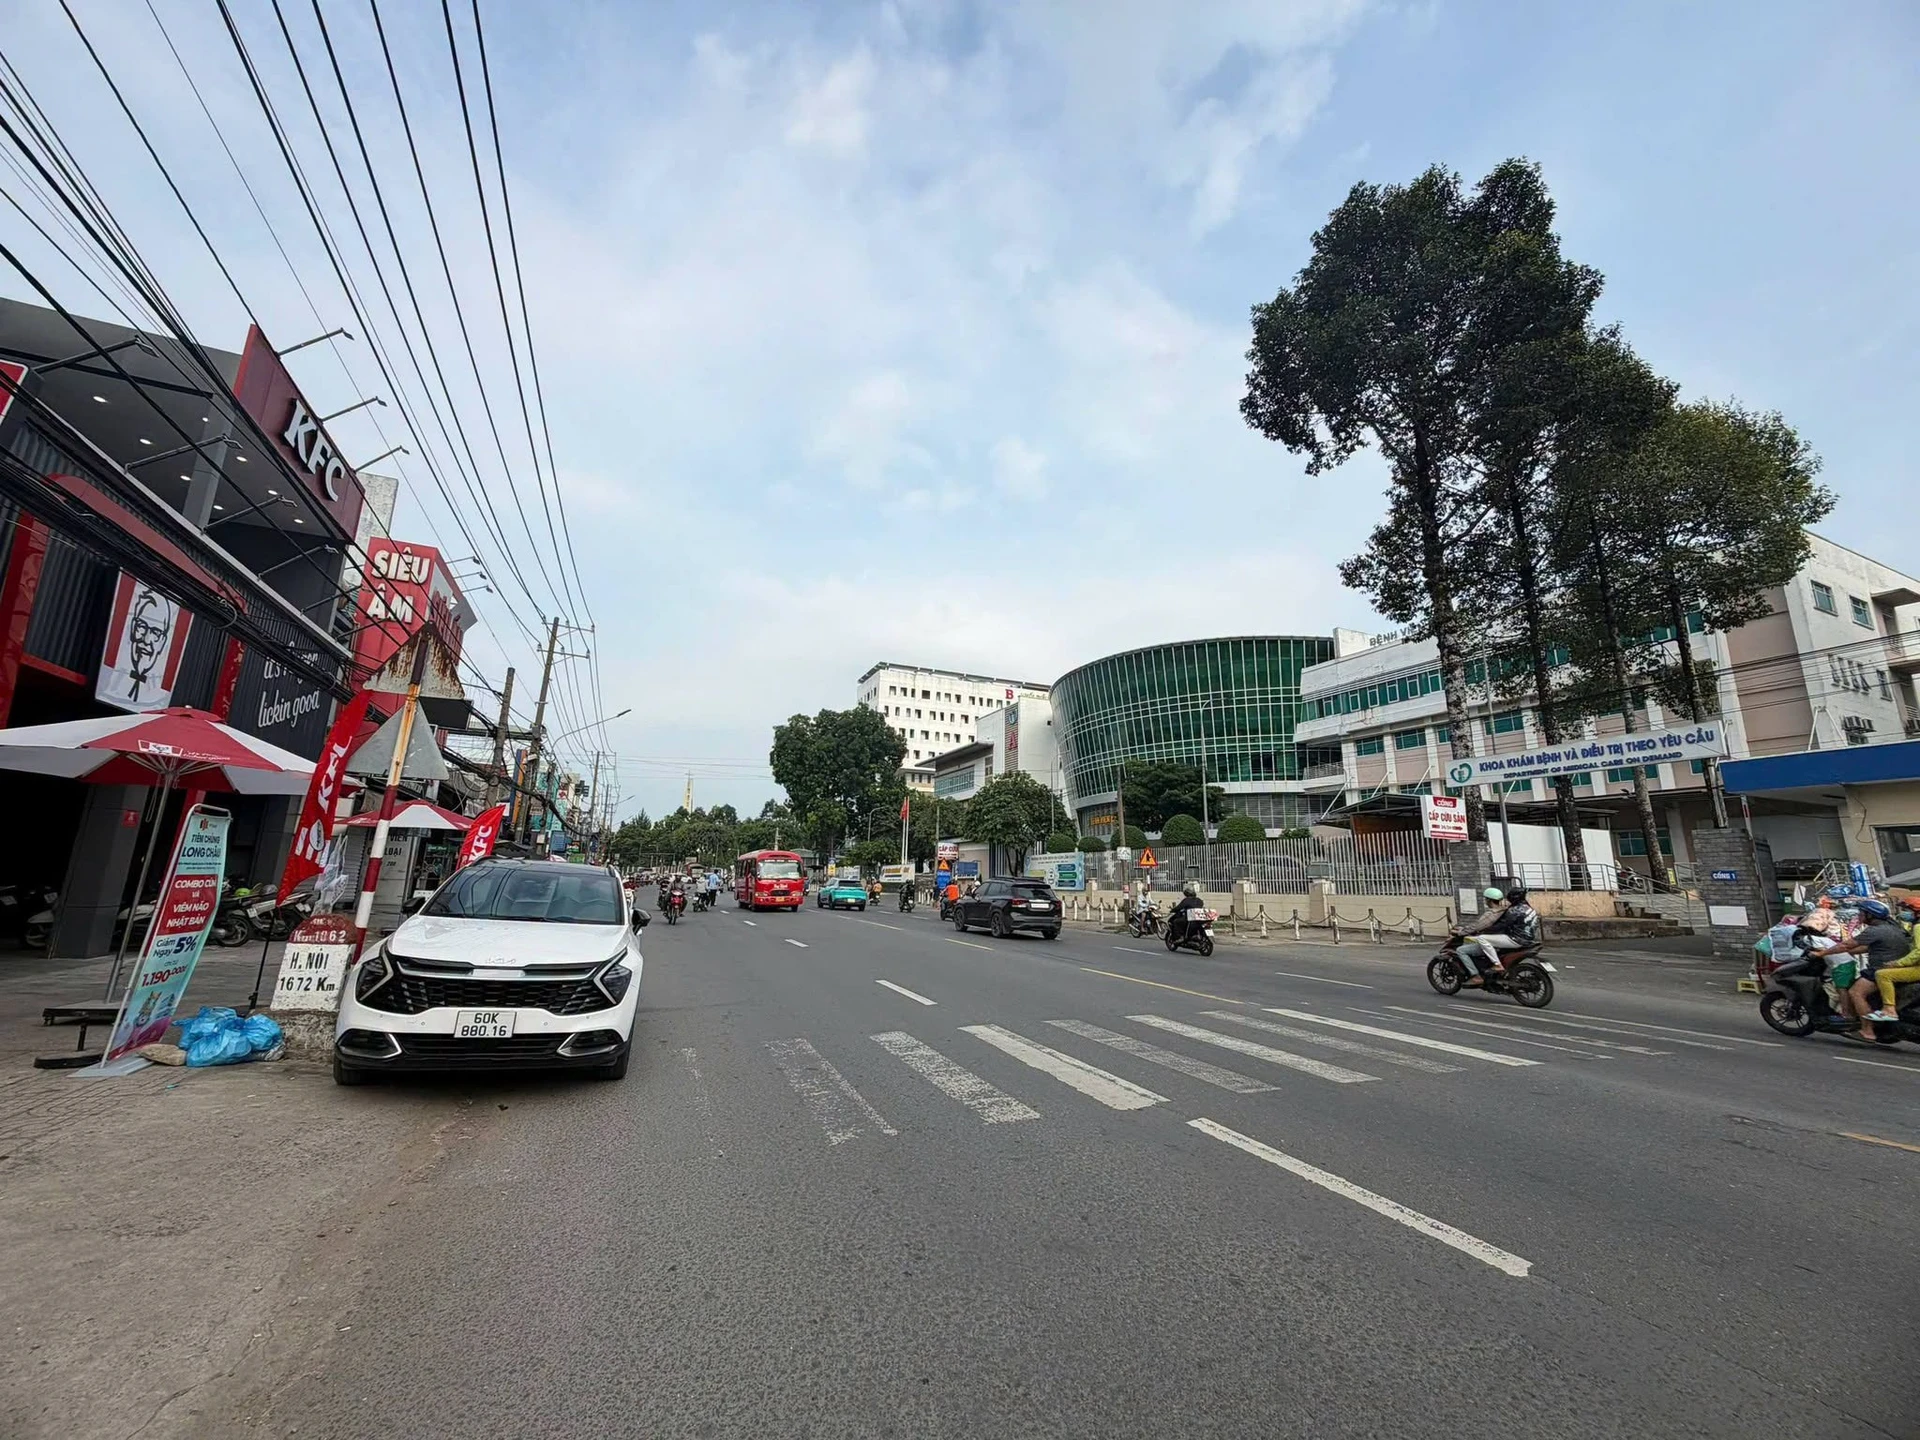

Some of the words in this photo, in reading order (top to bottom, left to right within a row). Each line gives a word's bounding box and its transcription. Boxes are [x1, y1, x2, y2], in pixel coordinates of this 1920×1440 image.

[284, 399, 346, 502] KFC
[371, 546, 430, 585] SIÊU
[366, 583, 414, 624] ÂM
[1005, 689, 1014, 699] B
[291, 688, 320, 728] good
[1479, 760, 1505, 772] KHOA
[1507, 753, 1535, 768] KHÁM
[1536, 751, 1561, 766] BỆNH
[1565, 747, 1579, 761] VÀ
[1581, 743, 1604, 757] ĐIỀU
[1607, 743, 1624, 756] TRỊ
[1626, 739, 1657, 753] THEO
[1658, 734, 1682, 748] YÊU
[1685, 728, 1715, 744] CẦU
[1503, 768, 1549, 779] DEPARTMENT
[1563, 762, 1599, 772] MEDICAL
[1601, 758, 1624, 768] CARE
[1625, 756, 1641, 765] ON
[1642, 752, 1683, 763] DEMAND
[182, 847, 206, 858] LONG
[469, 826, 492, 864] KFC
[175, 880, 204, 889] COMBO
[173, 902, 191, 913] VIÊM
[173, 935, 199, 954] 5%
[152, 948, 173, 958] Ngay
[280, 977, 312, 991] 1672
[316, 977, 335, 991] Km
[474, 1013, 499, 1024] 60K
[461, 1025, 507, 1037] 880.16
